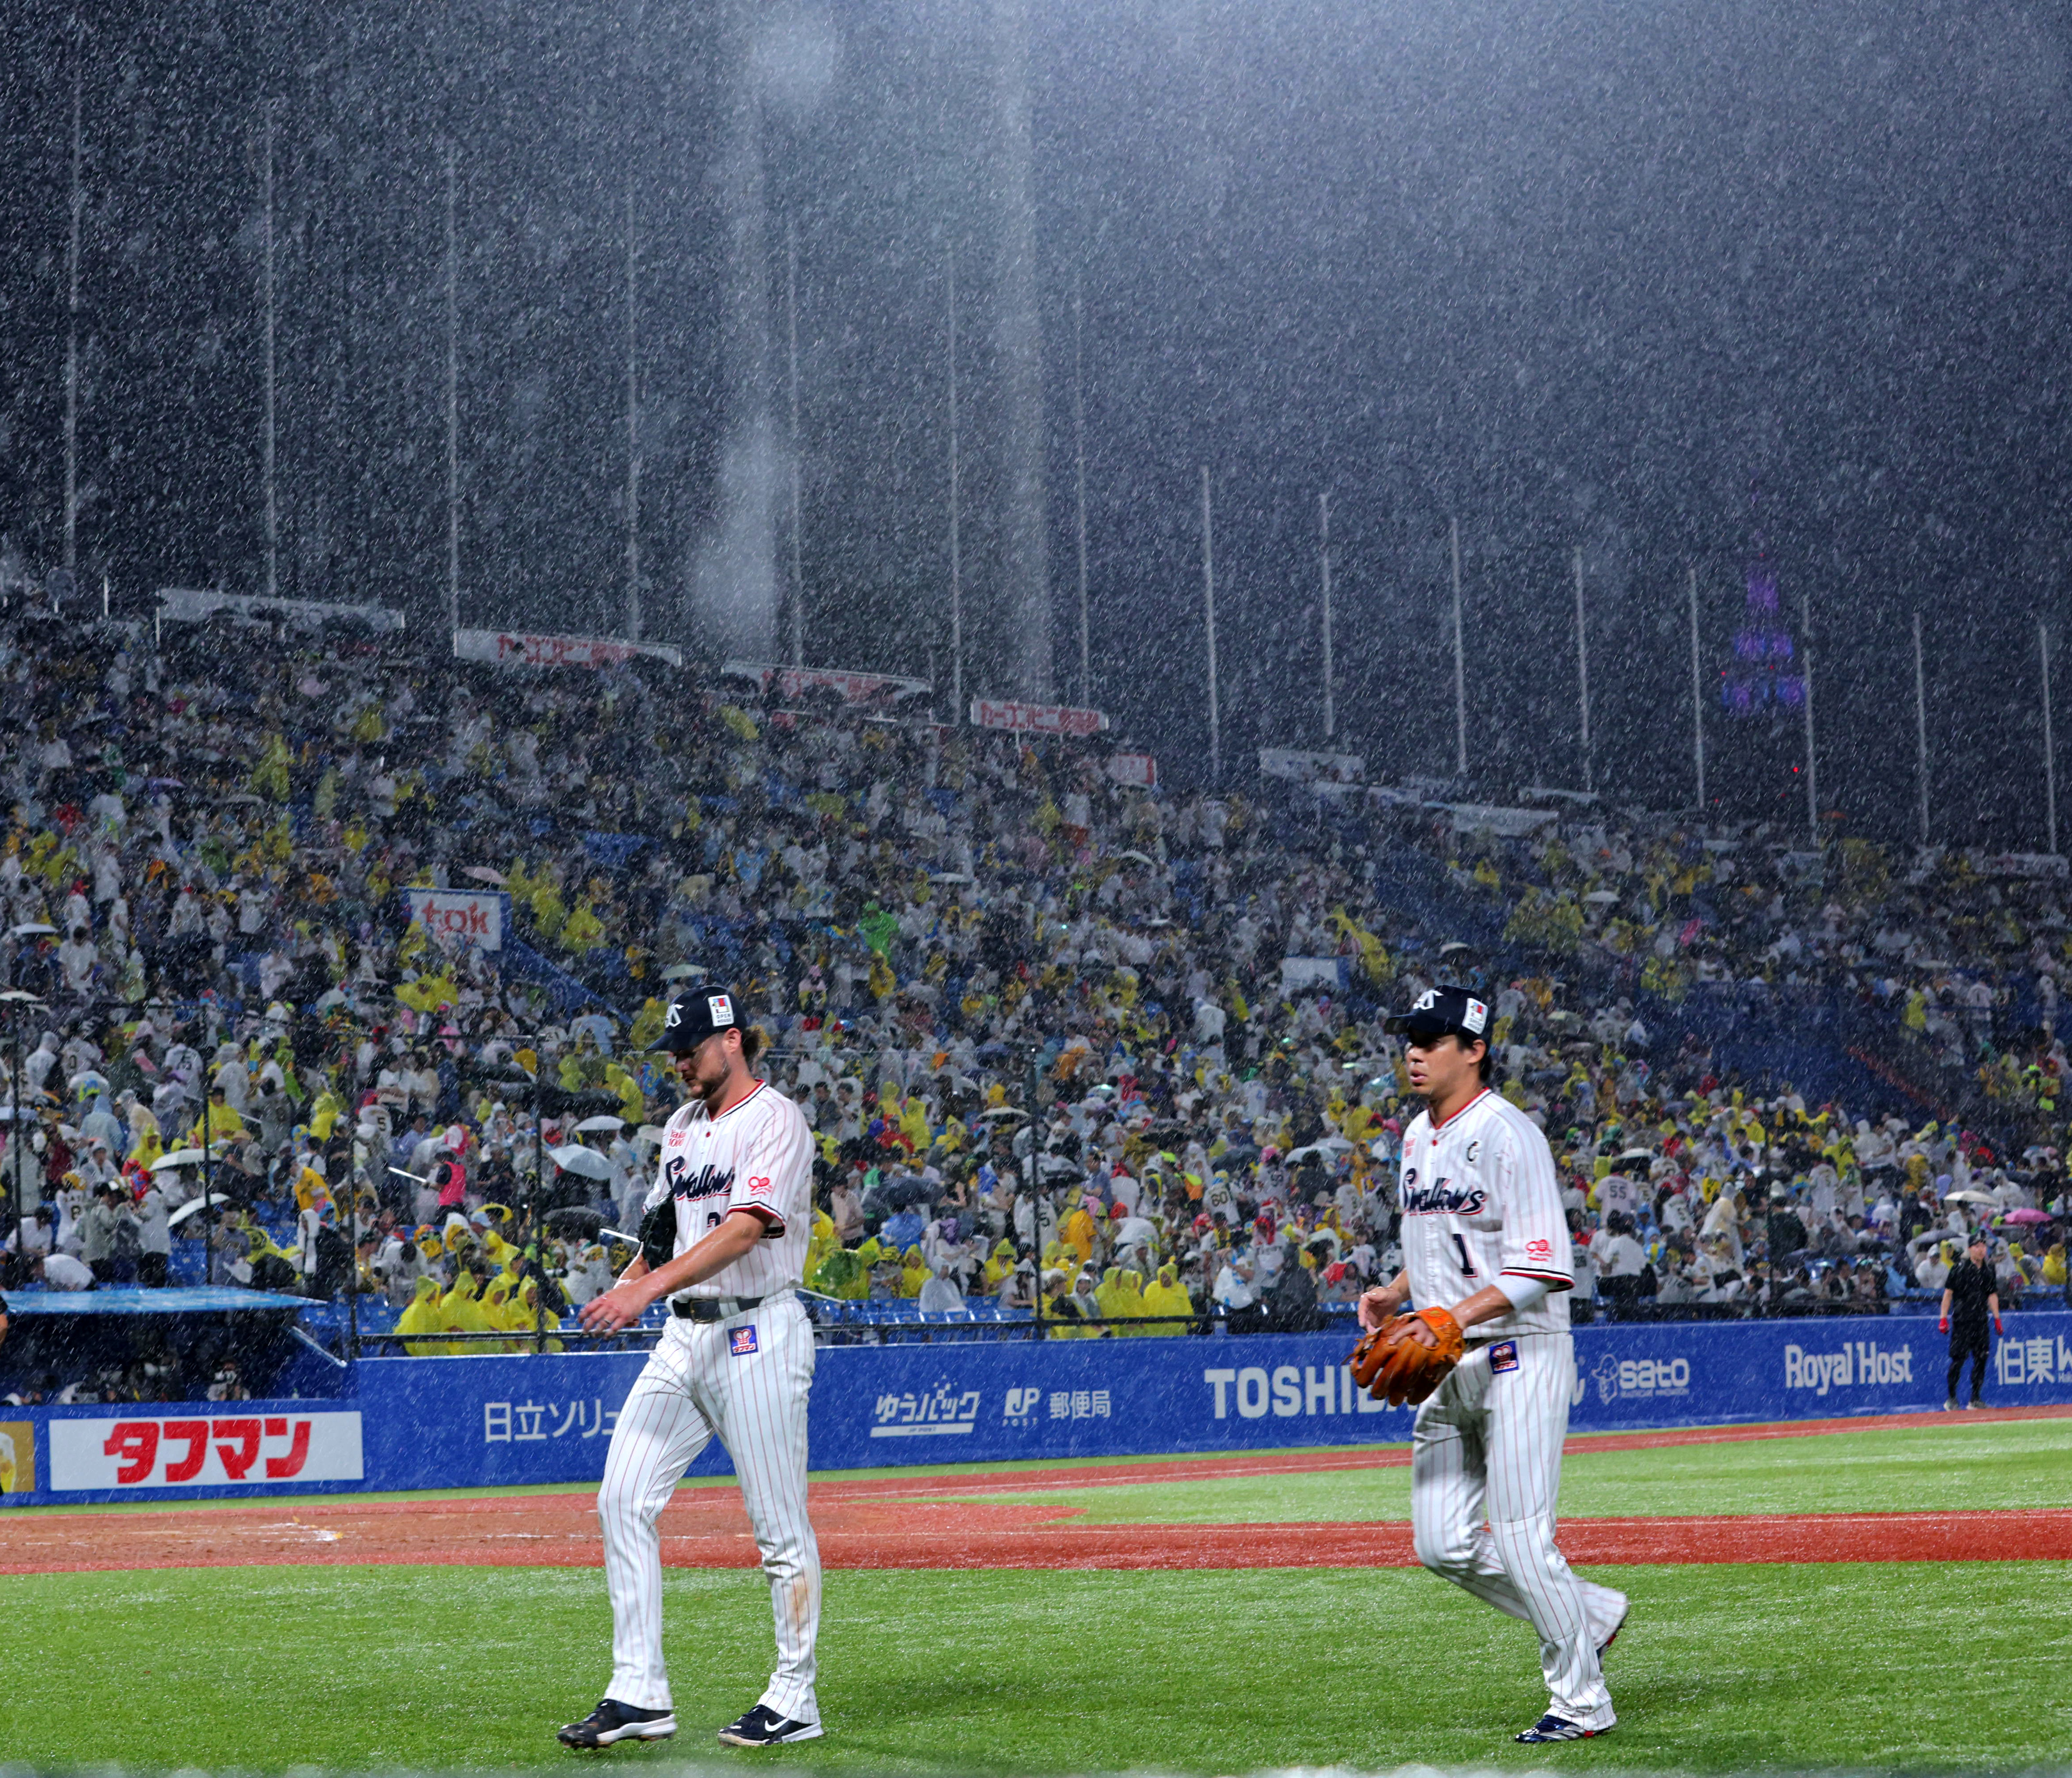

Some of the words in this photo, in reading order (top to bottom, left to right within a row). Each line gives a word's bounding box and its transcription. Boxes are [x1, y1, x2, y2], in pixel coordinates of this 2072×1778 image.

[1467, 1141, 1479, 1162] C
[1451, 1233, 1478, 1278] 1
[1619, 1358, 1689, 1389] sato
[1785, 1342, 1852, 1395] Royal
[1856, 1342, 1912, 1384] Host
[1994, 1336, 2055, 1386] 伯東
[874, 1390, 980, 1423] ゆうパック
[1049, 1390, 1111, 1419] 郵便局
[1204, 1366, 1418, 1419] TOSHI
[1002, 1418, 1038, 1426] POST
[103, 1418, 311, 1484] タフマン
